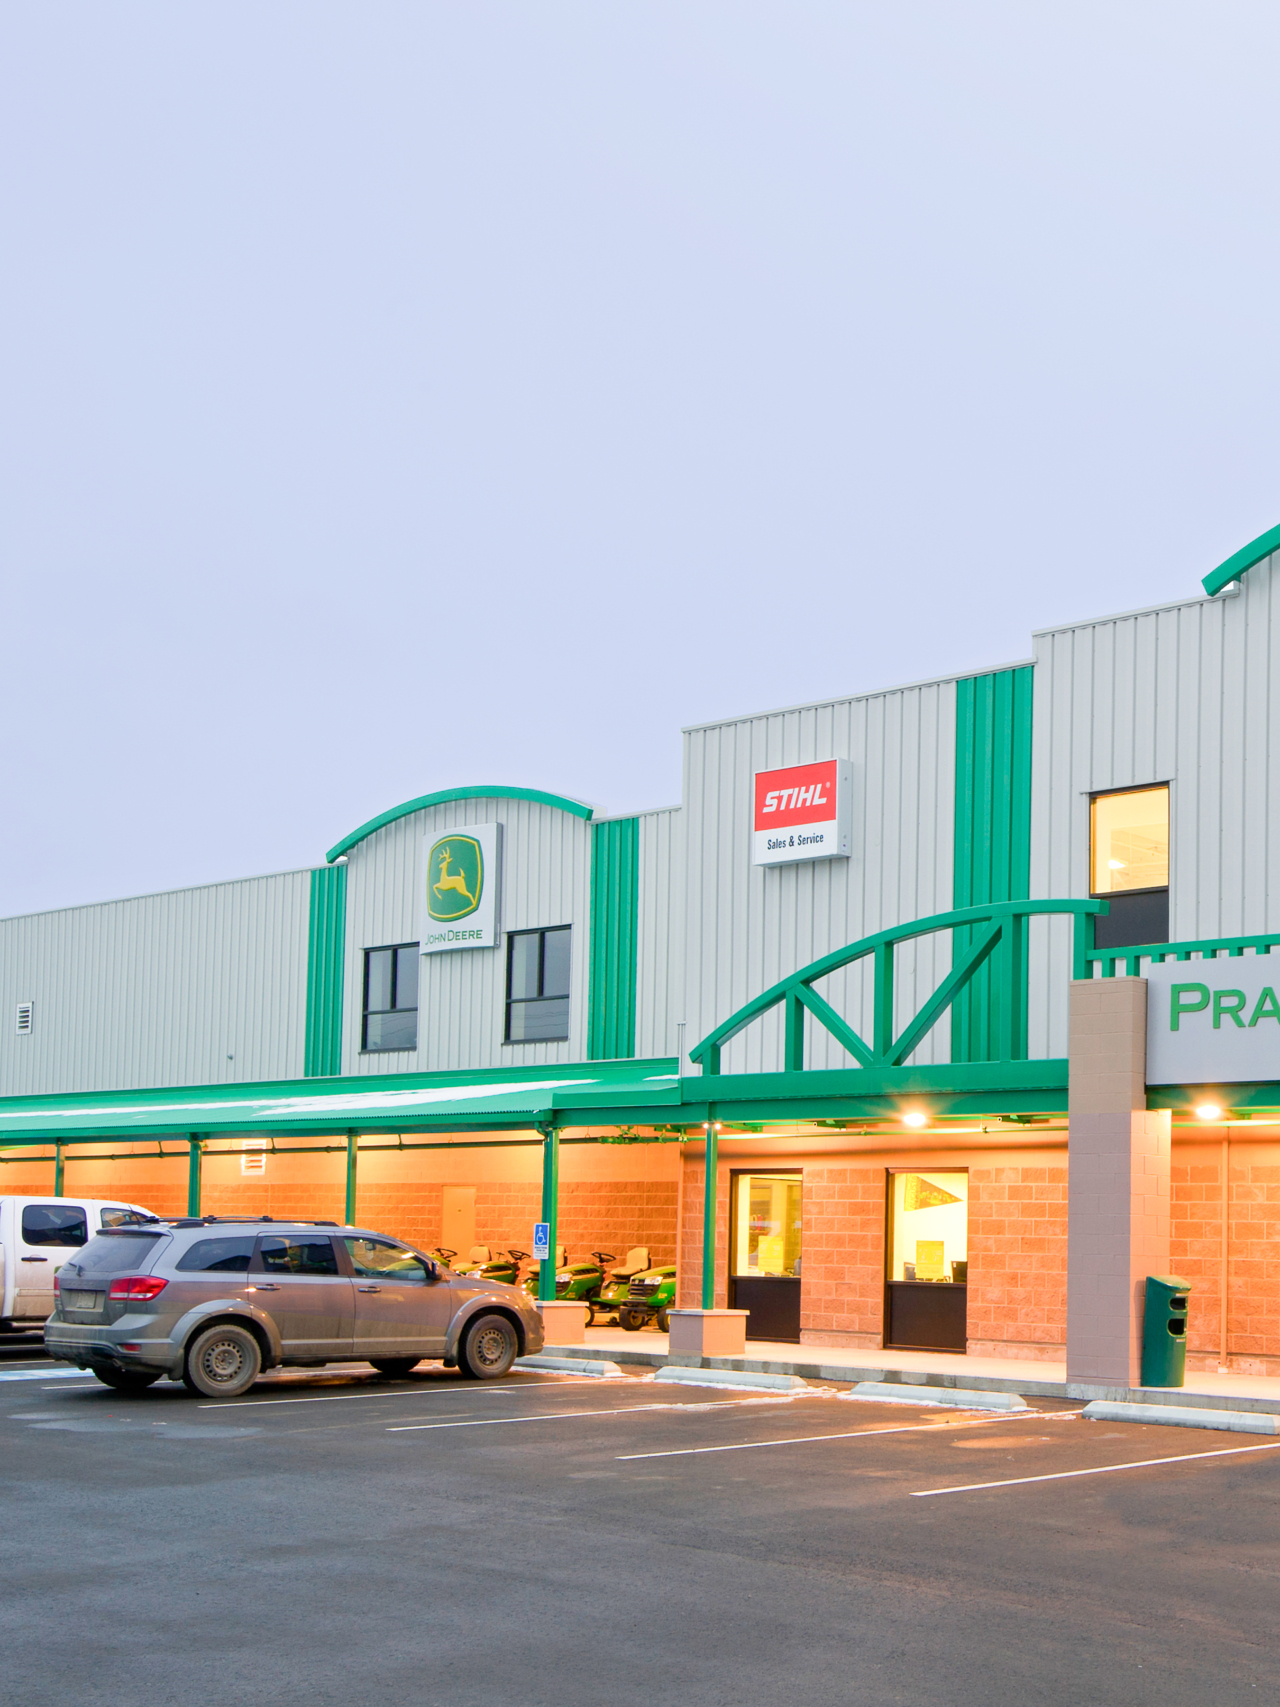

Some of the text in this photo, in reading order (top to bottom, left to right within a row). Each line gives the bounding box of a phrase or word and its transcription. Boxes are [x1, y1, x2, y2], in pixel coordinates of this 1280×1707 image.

[762, 783, 827, 813] STIHL
[767, 832, 824, 850] Sales & Service
[425, 930, 483, 945] JOHN DEERE
